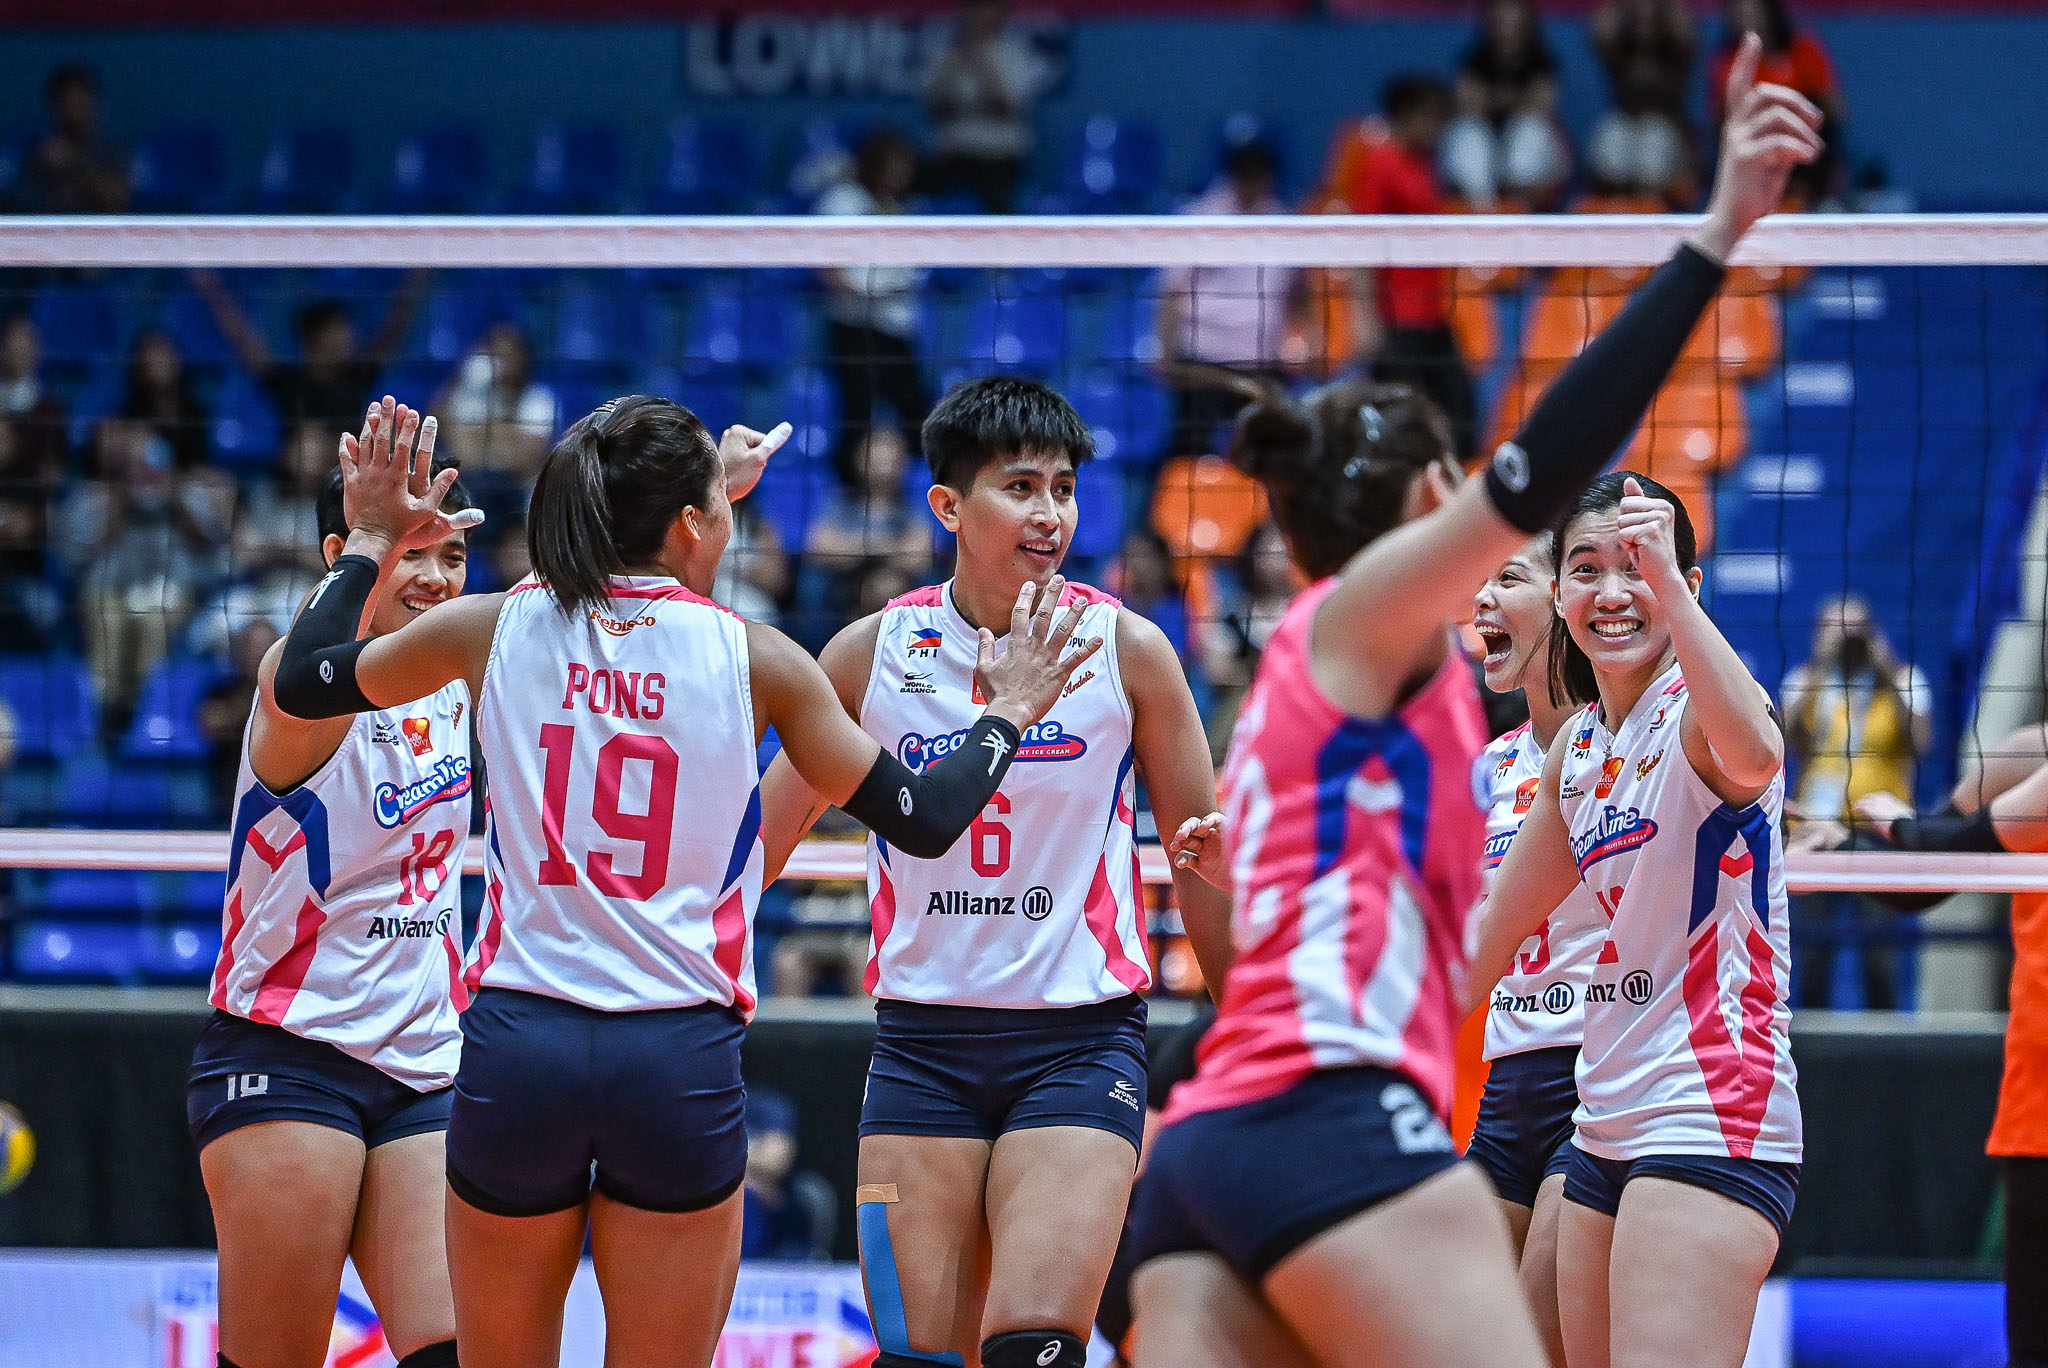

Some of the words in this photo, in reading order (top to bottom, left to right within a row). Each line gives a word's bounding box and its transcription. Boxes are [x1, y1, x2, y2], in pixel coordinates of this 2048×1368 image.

[590, 610, 656, 631] Rebisco
[908, 648, 937, 658] PHI
[562, 662, 666, 720] PONS
[538, 722, 679, 902] 19
[970, 791, 1011, 878] 6
[397, 828, 455, 906] 18
[926, 890, 1016, 916] Allianz
[1108, 1091, 1139, 1112] BALANCE
[1114, 1087, 1138, 1104] WORLD
